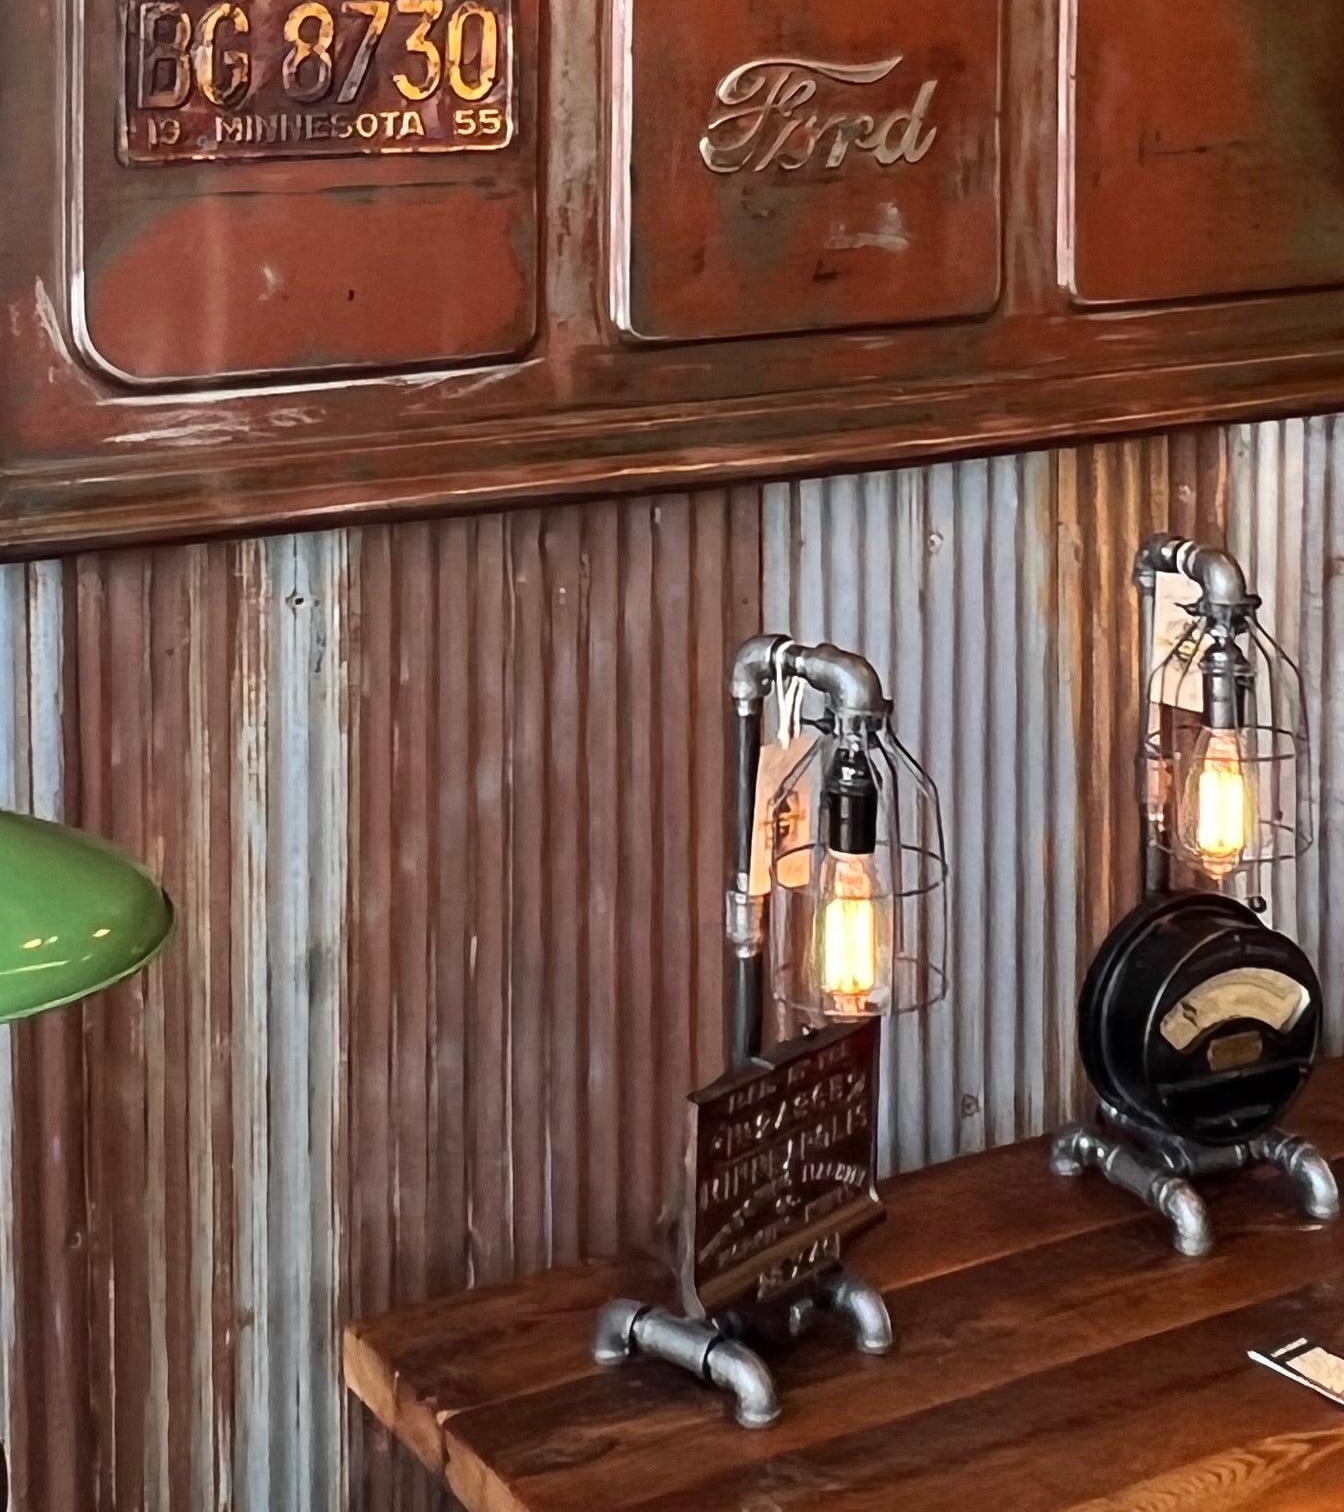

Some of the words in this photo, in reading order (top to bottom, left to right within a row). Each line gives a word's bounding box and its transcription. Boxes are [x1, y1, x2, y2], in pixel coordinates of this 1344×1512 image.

[137, 0, 250, 110] BG
[282, 0, 497, 105] 8730
[215, 109, 425, 144] MINNESOTA
[455, 109, 501, 136] 55
[698, 54, 938, 173] Ford
